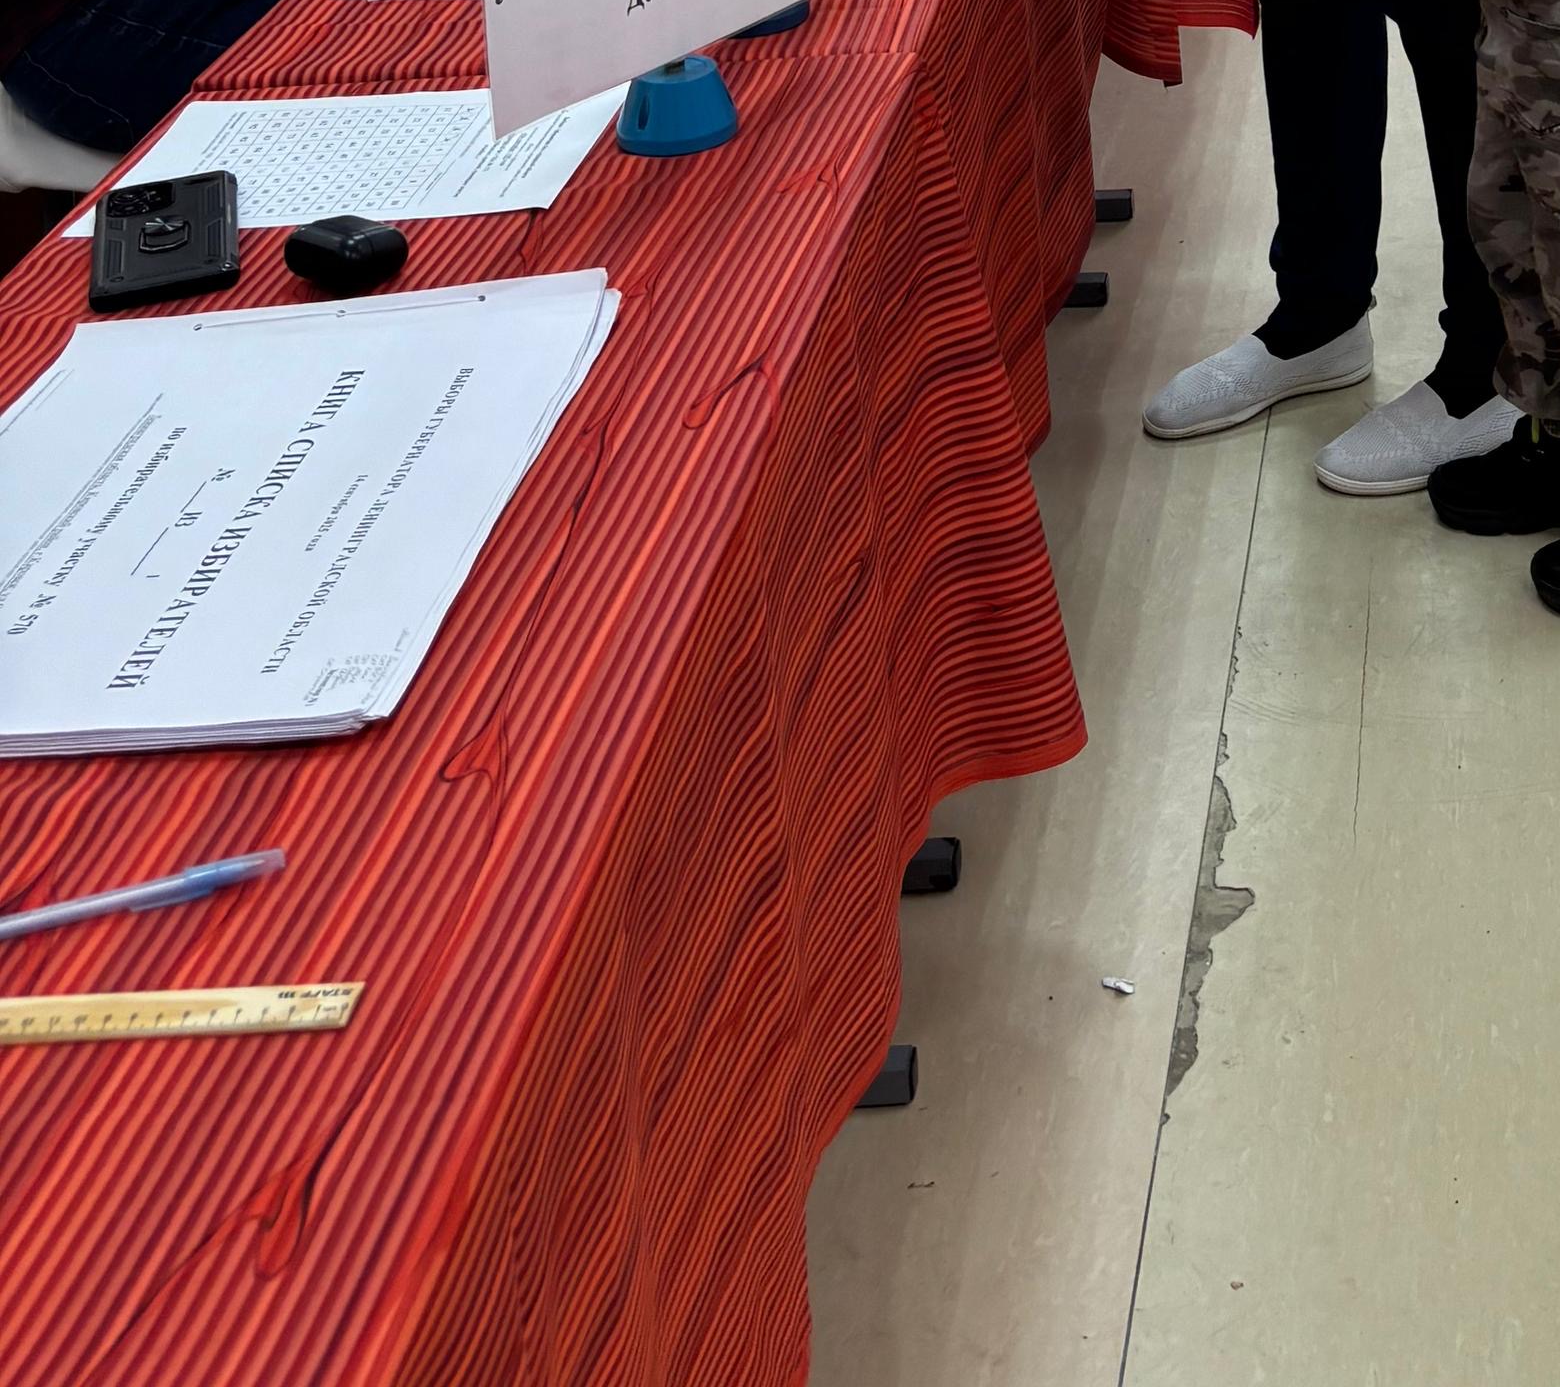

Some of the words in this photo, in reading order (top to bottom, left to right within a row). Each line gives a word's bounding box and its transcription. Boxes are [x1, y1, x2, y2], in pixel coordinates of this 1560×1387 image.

[299, 369, 366, 434] КНИГА
[434, 367, 474, 414] ВЫБОРЫ
[232, 438, 315, 522] СПИСКА
[380, 418, 443, 495] ГУБЕРНАТОРА
[306, 499, 389, 607] ЛЕНИНГРАДСКОЙ
[106, 527, 253, 690] ИЗБИРАТЕЛЕЙ
[260, 611, 316, 673] ОБЛАСТИ
